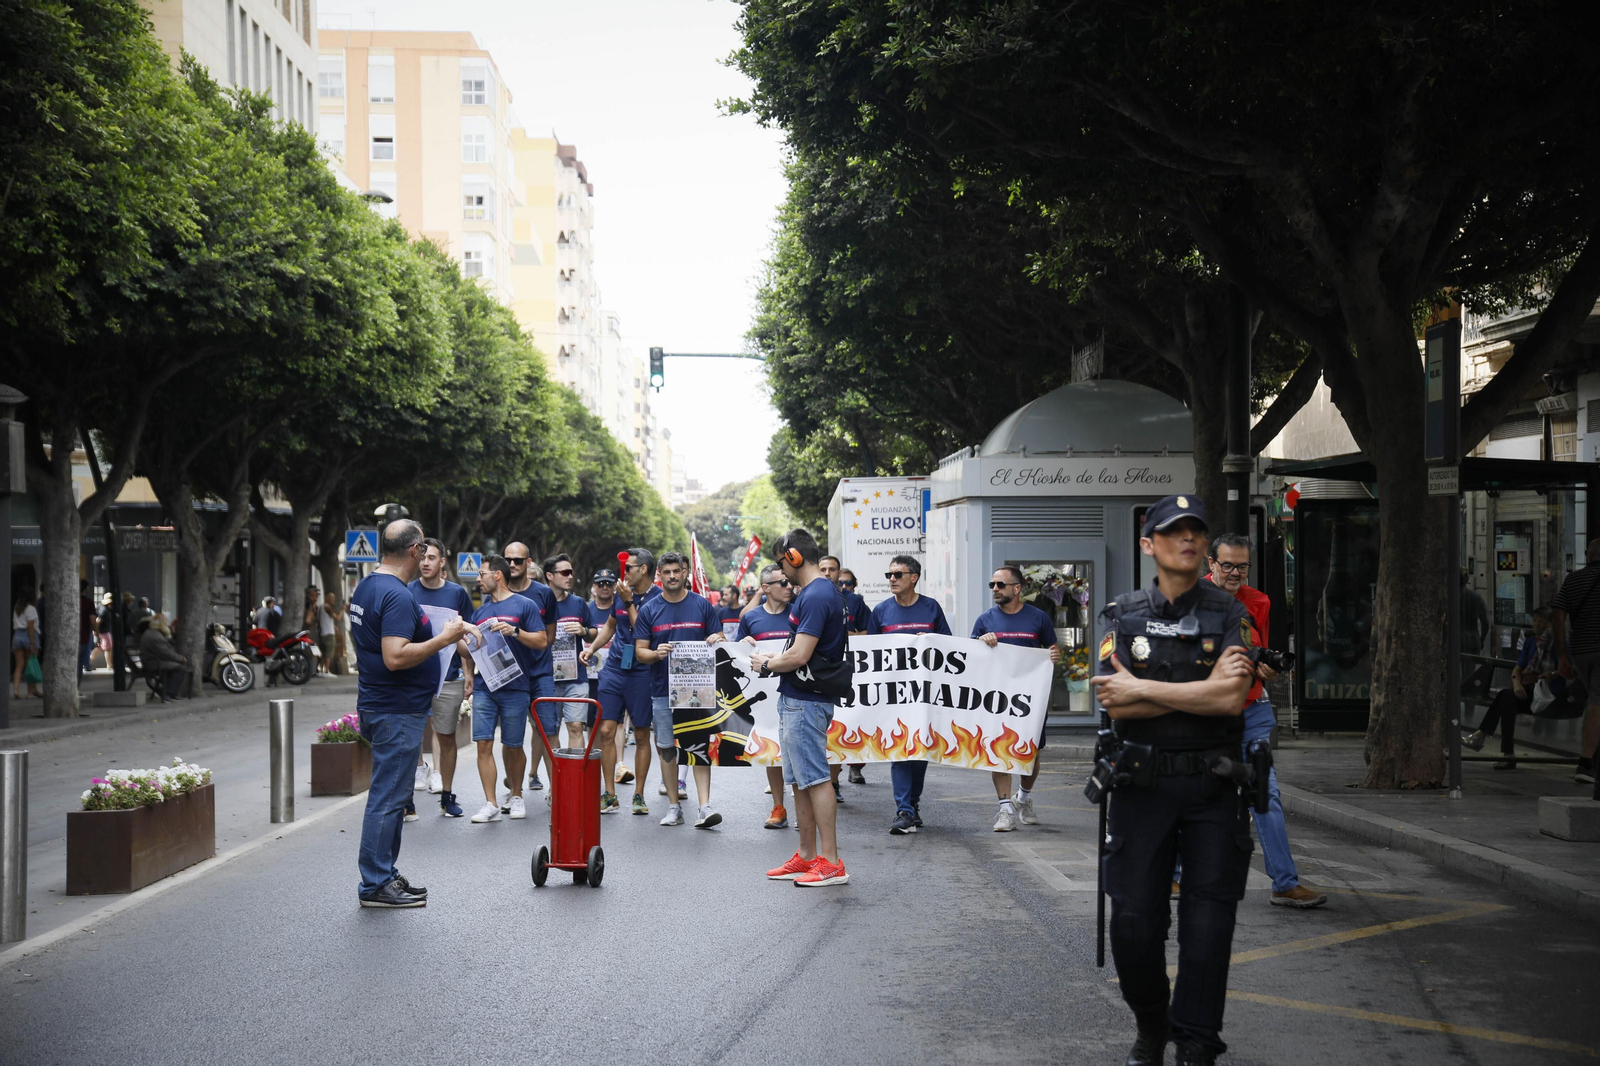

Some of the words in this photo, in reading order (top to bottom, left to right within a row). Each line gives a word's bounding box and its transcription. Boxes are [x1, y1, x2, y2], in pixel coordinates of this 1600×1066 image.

[990, 468, 1012, 486] El
[1014, 468, 1071, 486] Kiosko
[1076, 468, 1092, 484] de
[1098, 468, 1119, 484] las
[1124, 468, 1174, 485] Flores
[871, 506, 911, 514] MUDANZAS
[872, 516, 921, 530] EURO
[857, 537, 904, 545] NACIONALES
[906, 537, 911, 545] E
